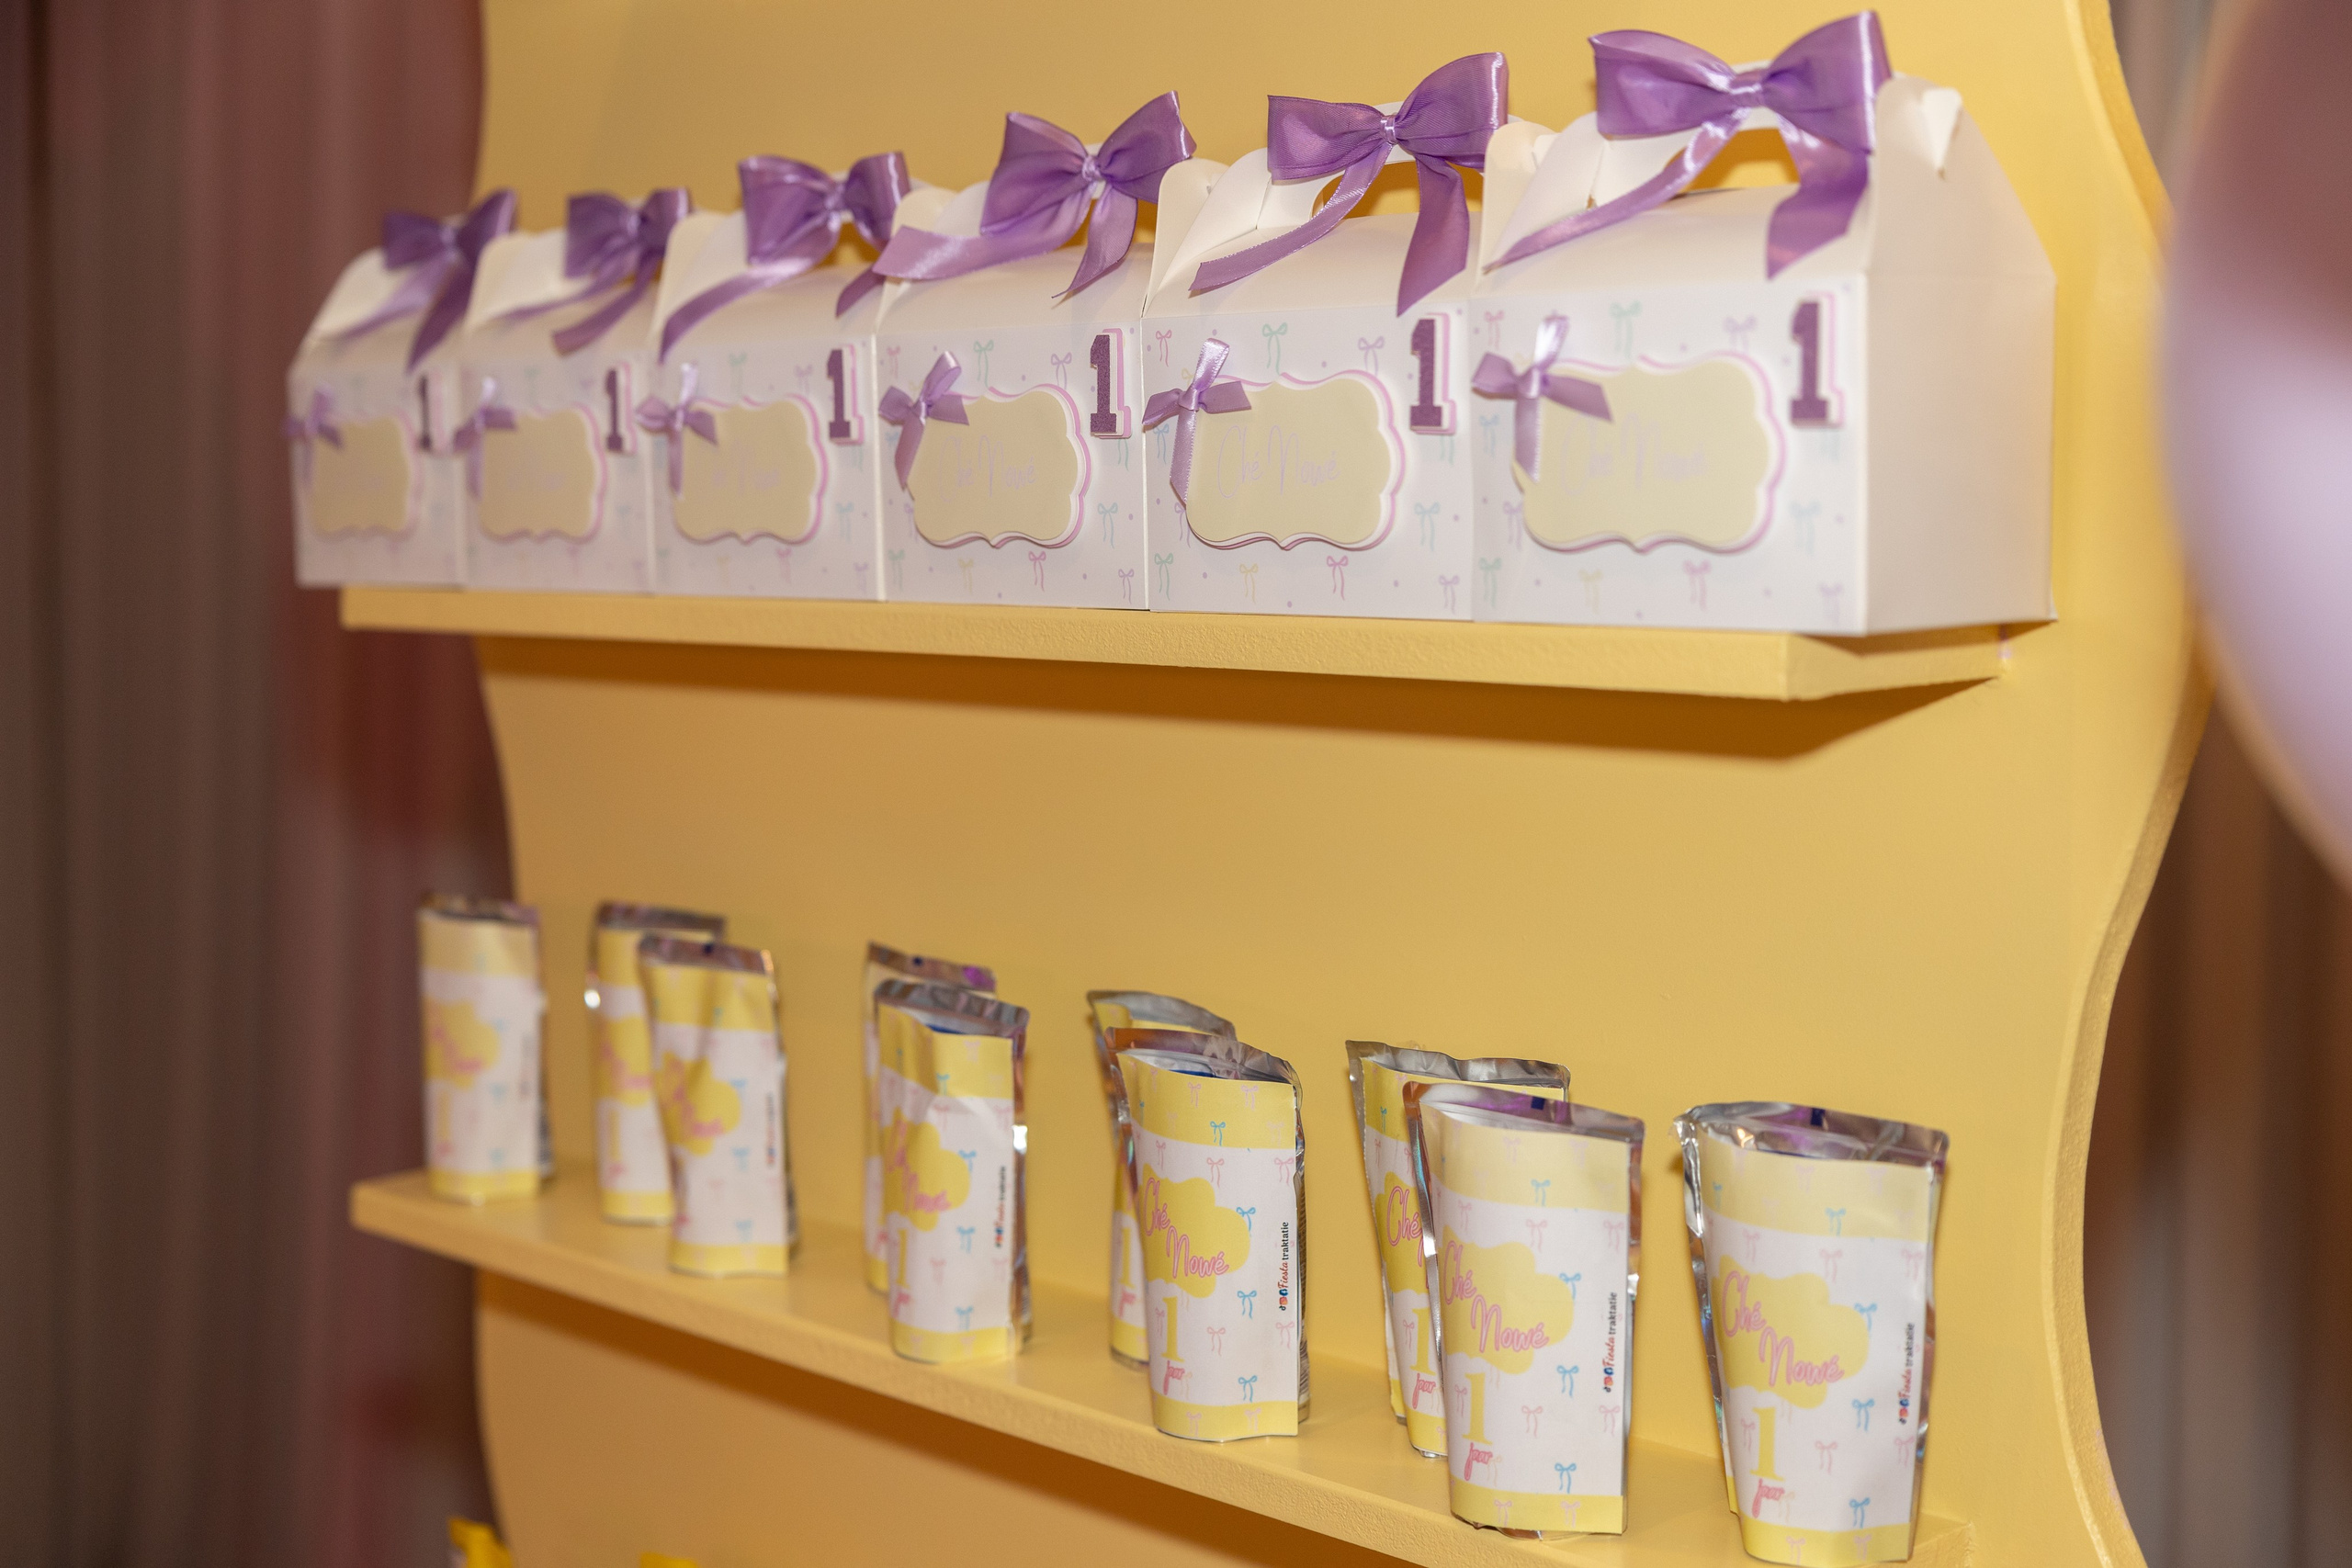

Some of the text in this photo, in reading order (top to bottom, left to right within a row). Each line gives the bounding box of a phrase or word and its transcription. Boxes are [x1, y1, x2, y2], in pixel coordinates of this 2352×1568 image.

[827, 346, 862, 444] 1
[1090, 329, 1130, 438] 1
[1410, 314, 1453, 434] 1
[1791, 295, 1842, 428] 1
[604, 364, 636, 453] 1
[1144, 1178, 1170, 1236] Ché
[1387, 1186, 1422, 1247] Ché
[1166, 1225, 1229, 1279] Nowé
[1277, 1222, 1289, 1290] Fiesta traktatie
[1443, 1240, 1477, 1306] Ché
[1161, 1296, 1185, 1362] 1
[1471, 1294, 1550, 1354] Nowé
[1602, 1292, 1619, 1368] Fiesta traktatie
[1722, 1271, 1767, 1337] Ché
[1409, 1307, 1436, 1376] 1
[1758, 1328, 1844, 1387] Nowé
[1461, 1371, 1493, 1445] 1
[1750, 1406, 1784, 1481] 1
